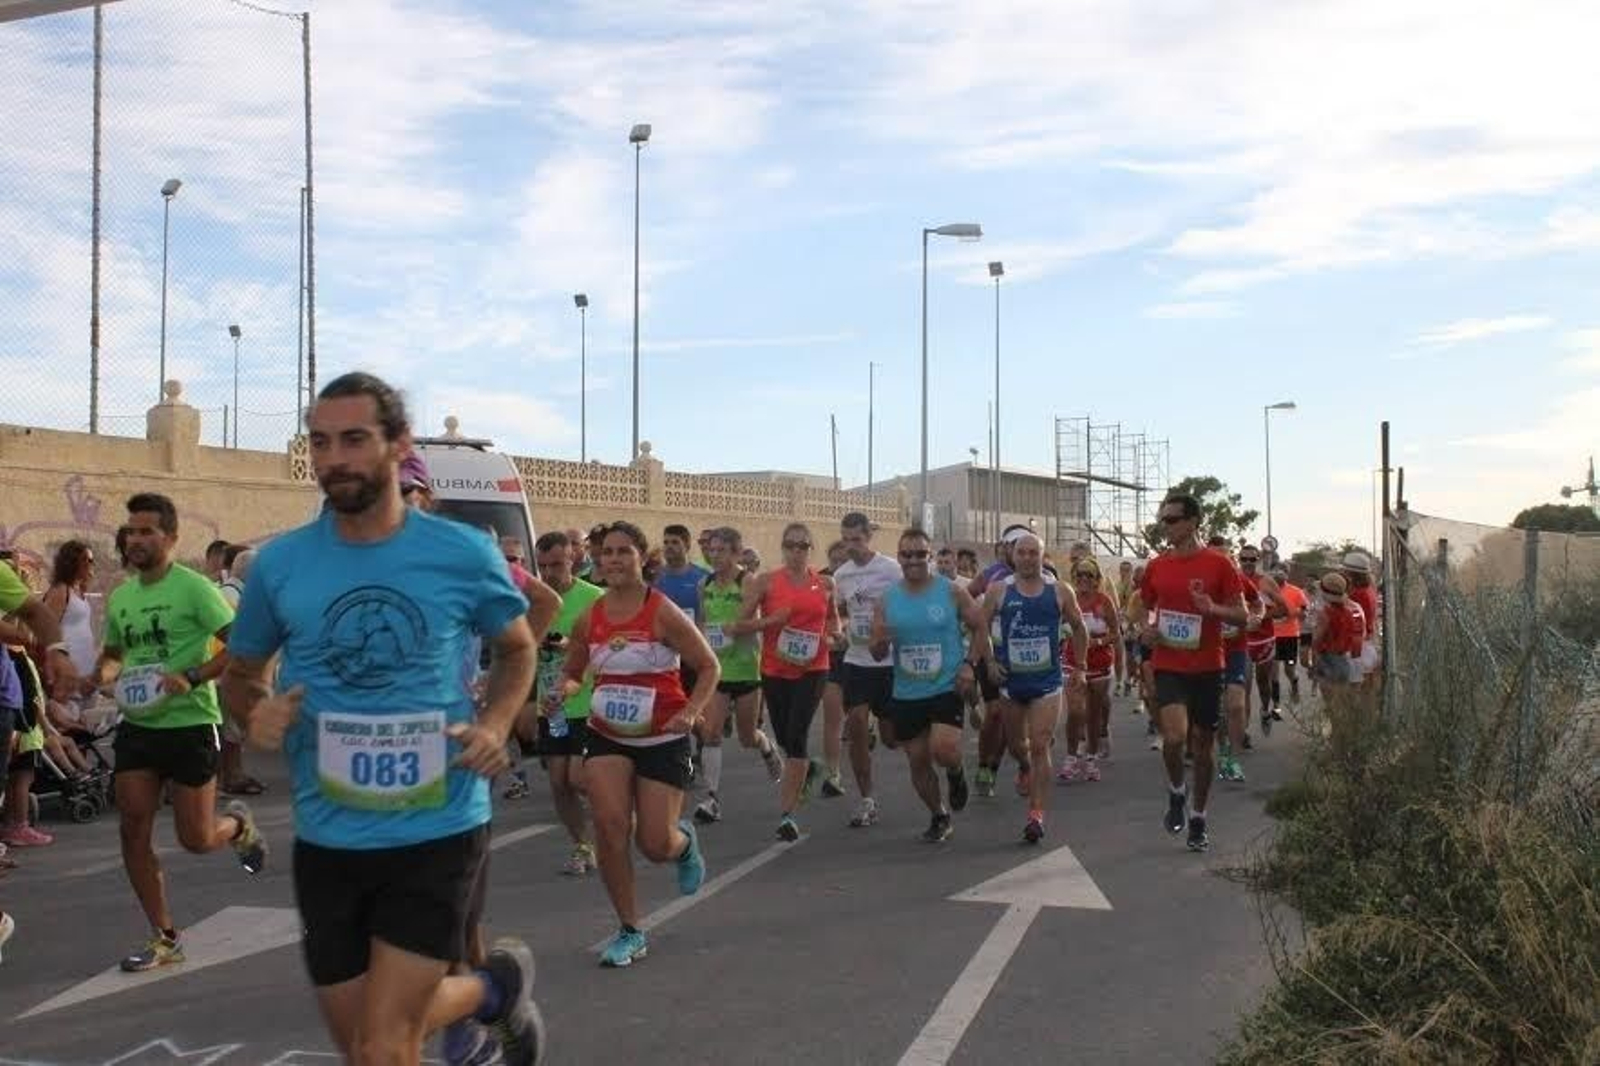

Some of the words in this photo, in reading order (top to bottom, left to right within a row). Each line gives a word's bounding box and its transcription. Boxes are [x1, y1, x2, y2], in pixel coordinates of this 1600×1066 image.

[124, 683, 147, 704] 173
[605, 700, 639, 722] 092
[351, 751, 420, 788] 083
